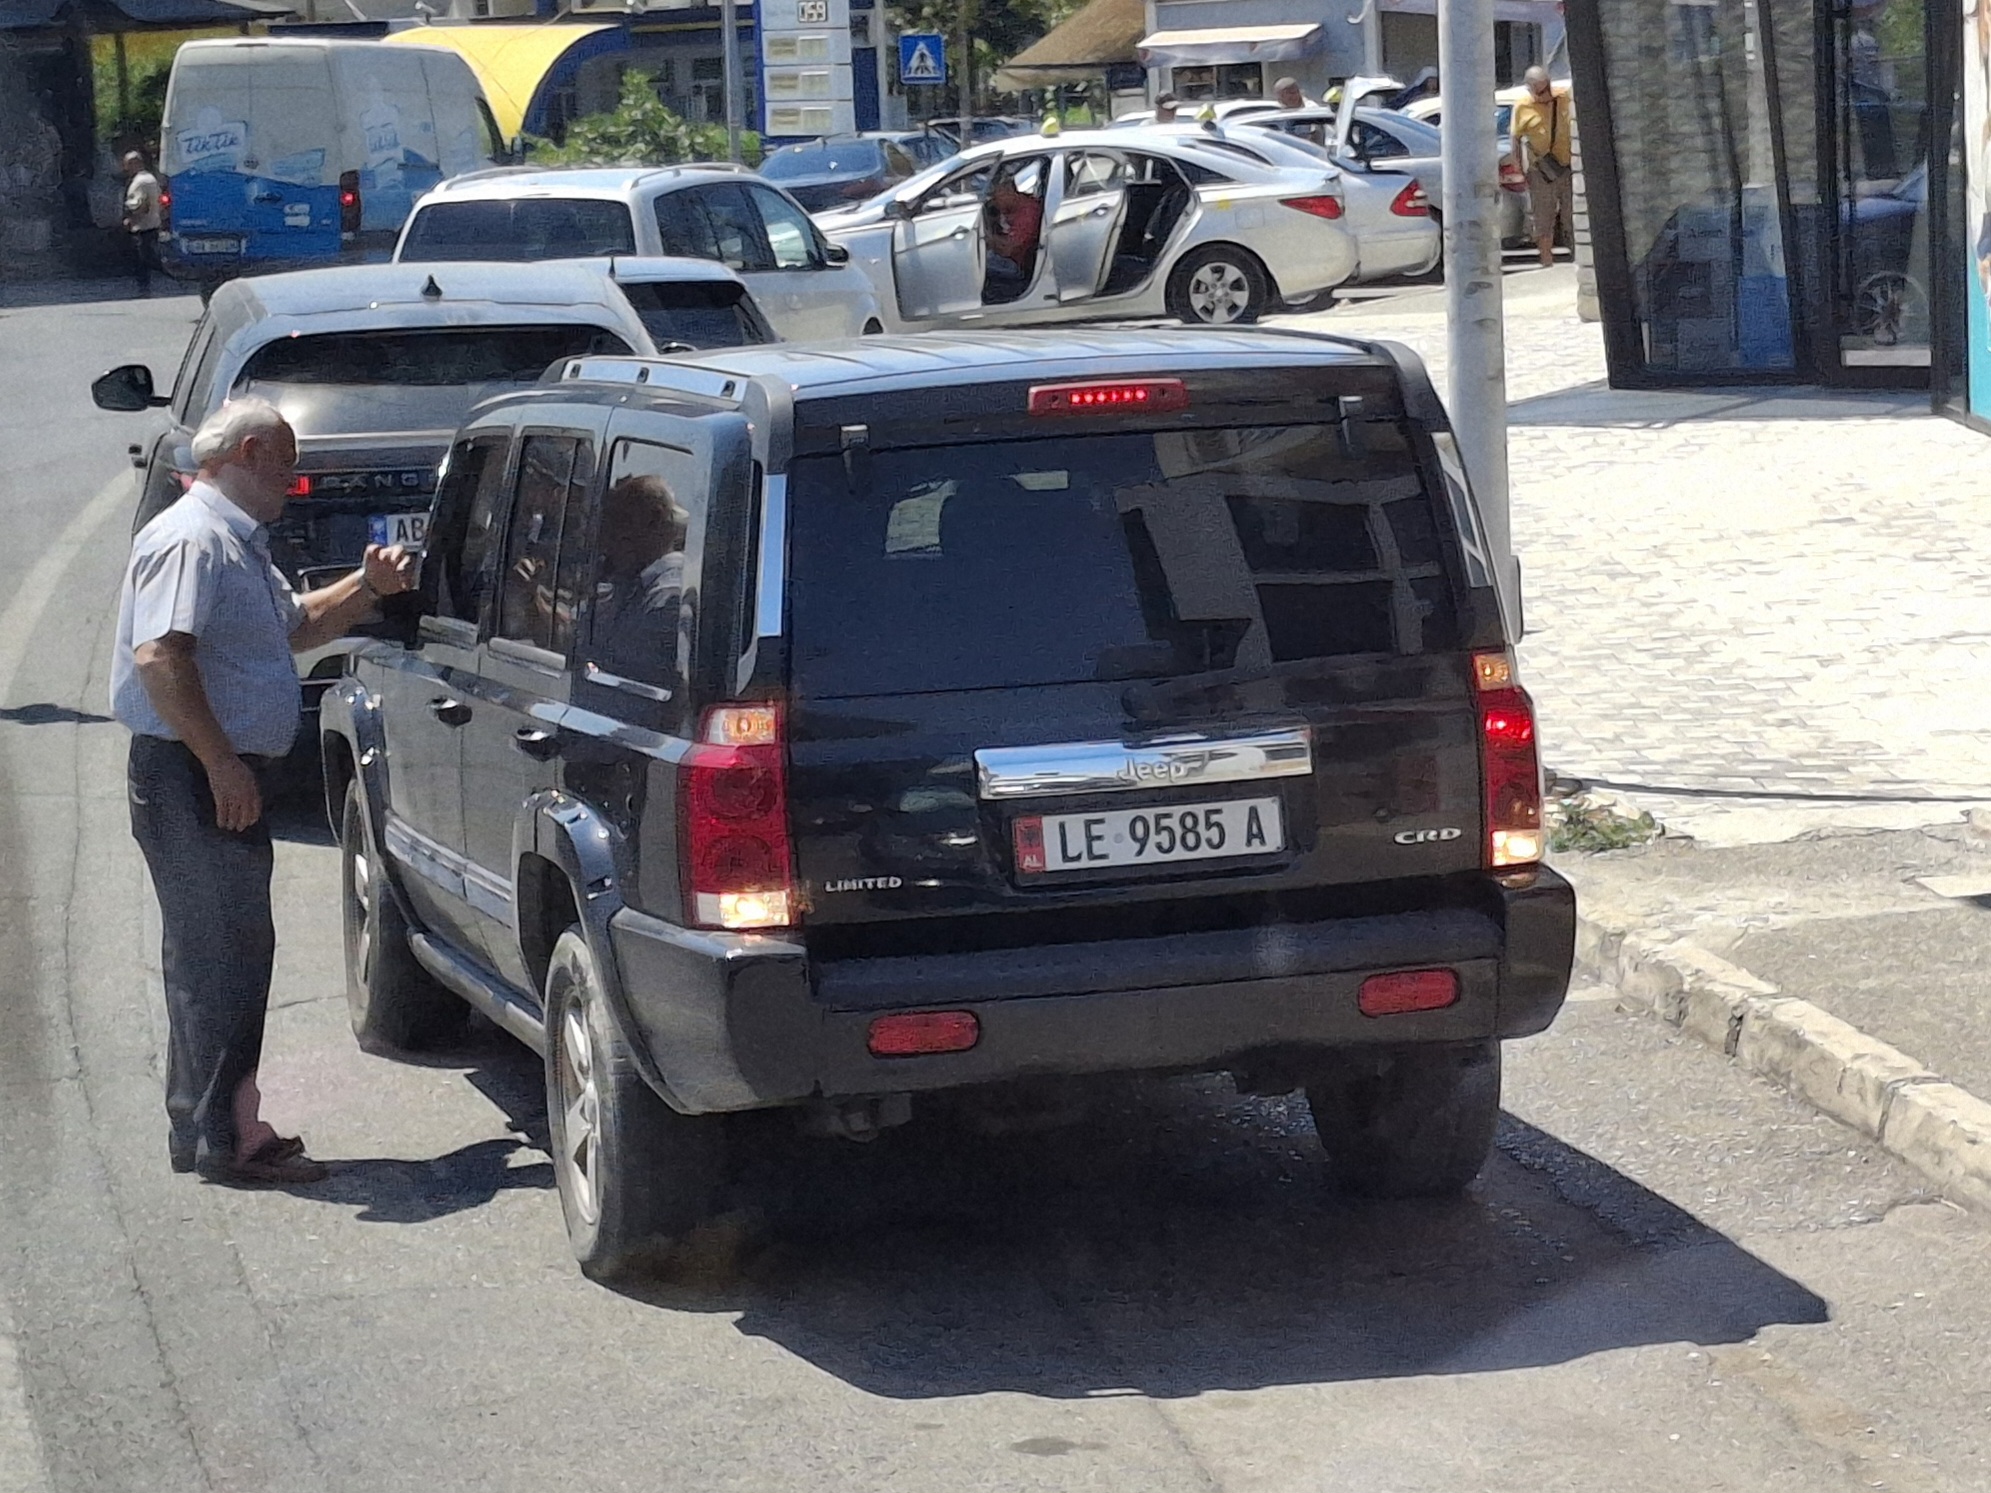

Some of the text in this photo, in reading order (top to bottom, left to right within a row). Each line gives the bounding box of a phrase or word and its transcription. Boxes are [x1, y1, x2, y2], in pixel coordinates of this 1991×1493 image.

[1117, 755, 1188, 782] Jeep
[1058, 806, 1267, 863] LE 9585 A
[1393, 826, 1462, 845] CRD
[1024, 855, 1042, 868] AL
[824, 876, 902, 893] LIMITED
